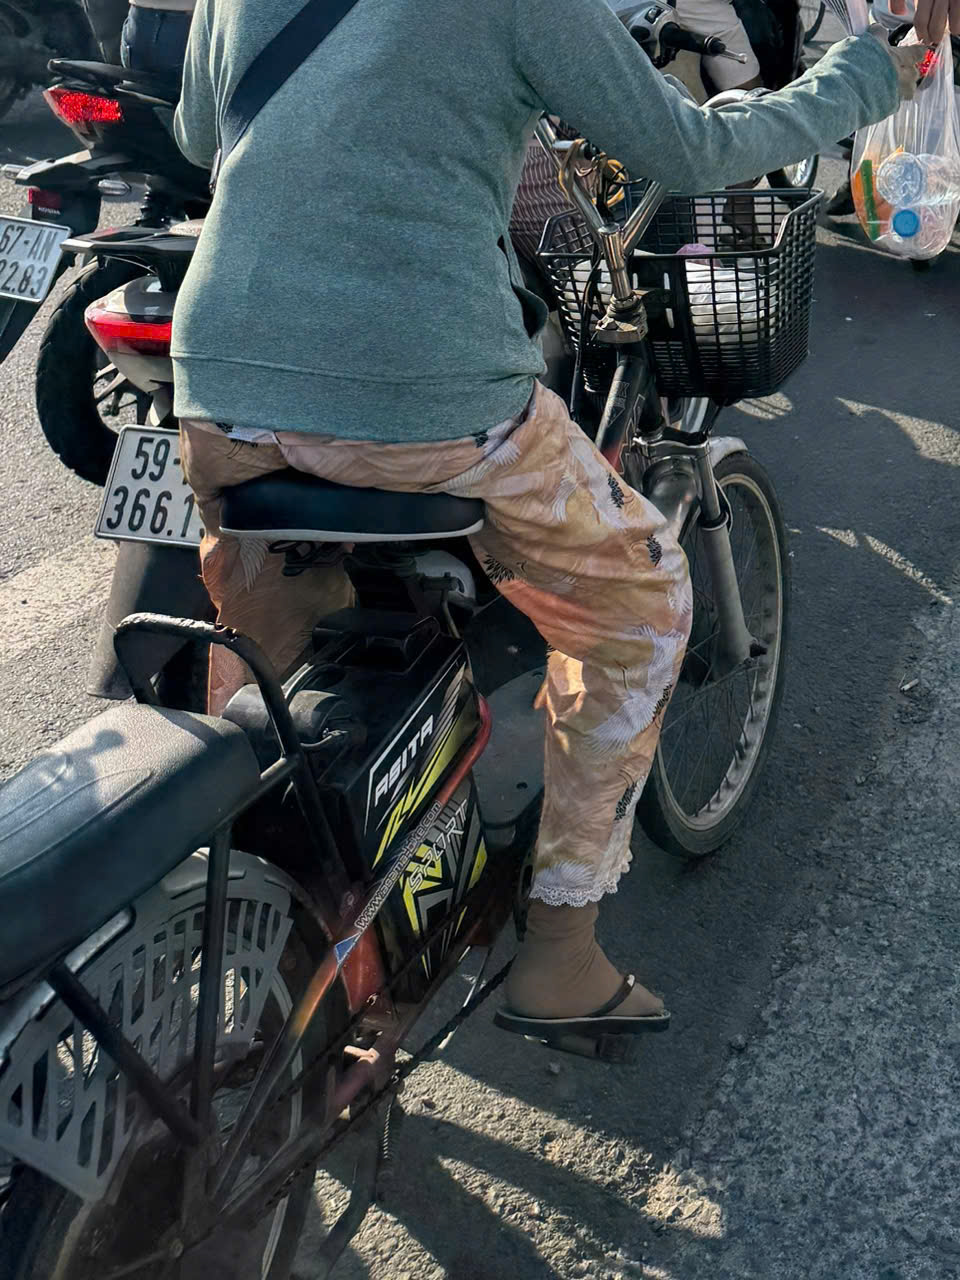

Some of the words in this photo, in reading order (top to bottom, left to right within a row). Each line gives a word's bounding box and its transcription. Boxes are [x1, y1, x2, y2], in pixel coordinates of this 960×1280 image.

[131, 437, 187, 485] 59-
[107, 486, 205, 538] 366.1
[375, 714, 434, 808] ASITA
[409, 798, 468, 894] SPORT
